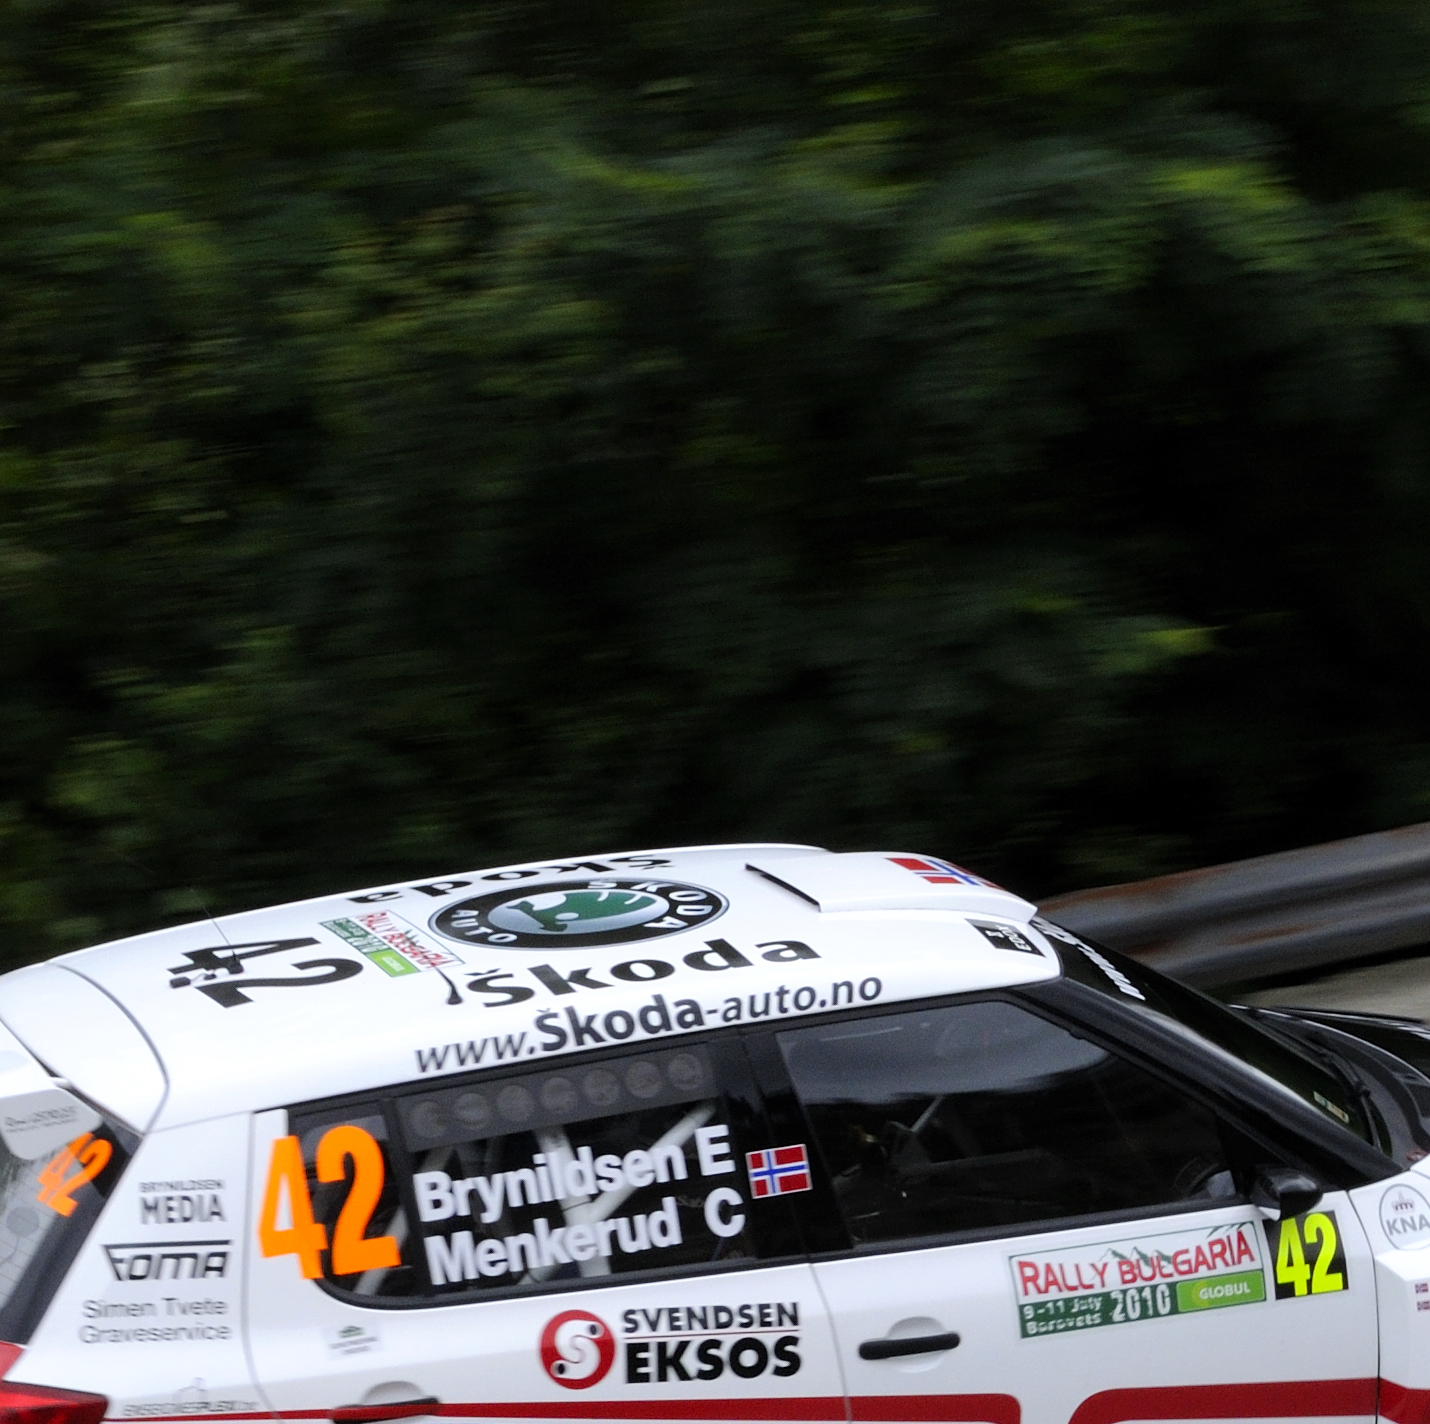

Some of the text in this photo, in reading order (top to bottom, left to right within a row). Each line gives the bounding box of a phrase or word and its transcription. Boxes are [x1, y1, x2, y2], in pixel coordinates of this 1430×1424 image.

[451, 908, 518, 944] AUTO
[167, 936, 364, 1009] 42
[464, 938, 822, 1008] Škoda
[415, 976, 883, 1073] www.Škoda-auto.no
[37, 1132, 113, 1217] 42
[257, 1125, 401, 1280] 42
[413, 1124, 736, 1223] Brynildsen E
[139, 1194, 227, 1225] MEDIA
[423, 1187, 747, 1286] Menkerud C
[1017, 1230, 1256, 1297] RALLY BULGARIA
[1276, 1212, 1344, 1297] 42
[82, 1297, 229, 1319] Simen Tvete
[621, 1301, 800, 1334] SVENDSEN
[1109, 1283, 1172, 1323] 2010
[1199, 1281, 1252, 1301] GLOBUL
[79, 1322, 232, 1344] Graveservice
[624, 1335, 802, 1384] EKSOS
